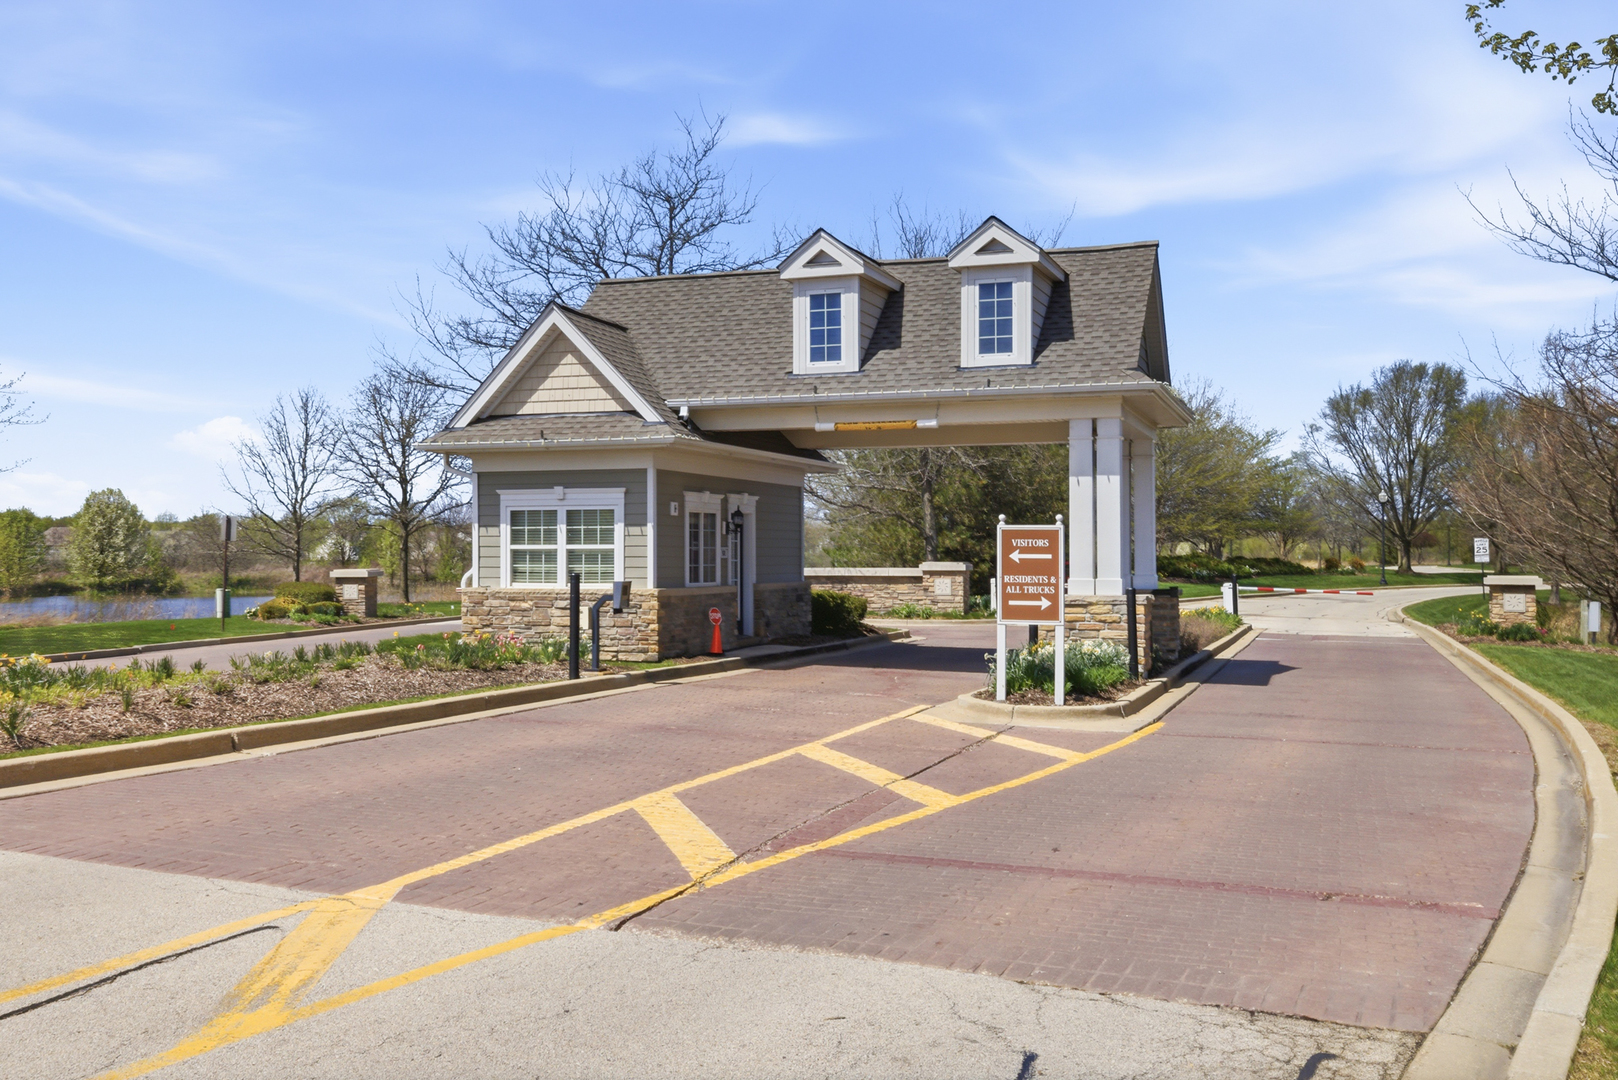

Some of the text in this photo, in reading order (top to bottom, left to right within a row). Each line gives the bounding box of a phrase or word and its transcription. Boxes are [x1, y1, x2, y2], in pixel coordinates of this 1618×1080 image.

[1011, 539, 1049, 547] VISITORS
[1476, 546, 1488, 554] 25
[1004, 575, 1057, 584] RESIDENTS &
[1006, 586, 1055, 594] ALL TRUCKS
